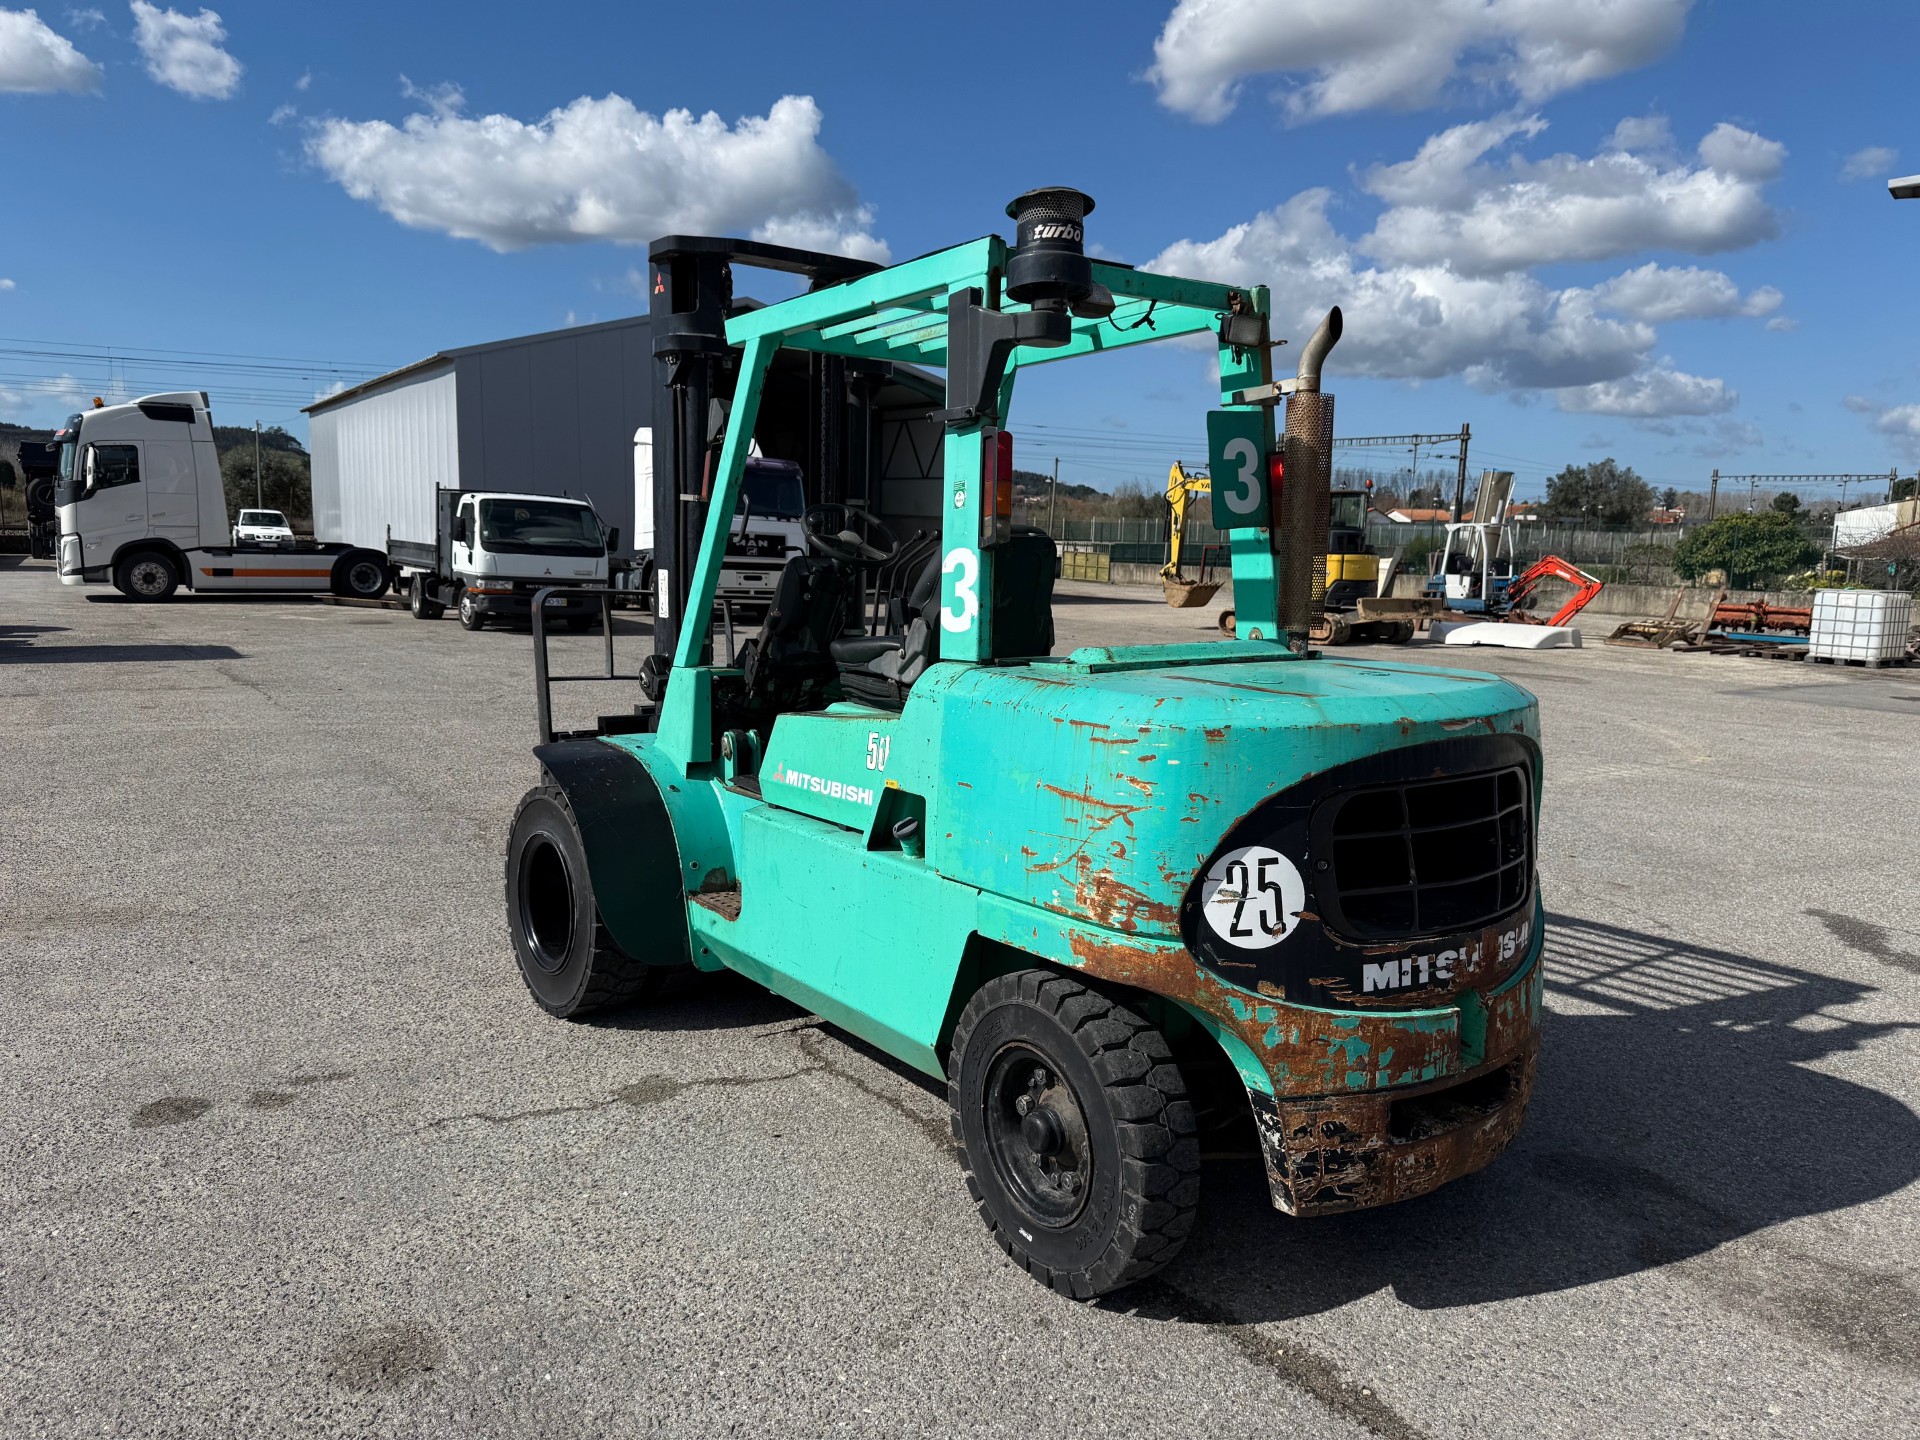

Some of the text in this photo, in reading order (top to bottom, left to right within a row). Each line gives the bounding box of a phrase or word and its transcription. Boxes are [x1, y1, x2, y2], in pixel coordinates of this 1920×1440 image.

[1034, 223, 1081, 242] turbo
[1223, 437, 1262, 515] 3
[941, 547, 978, 633] 3
[785, 768, 874, 806] MITSUBISHI
[1225, 857, 1287, 938] 25
[1363, 921, 1529, 993] MITSUISHI
